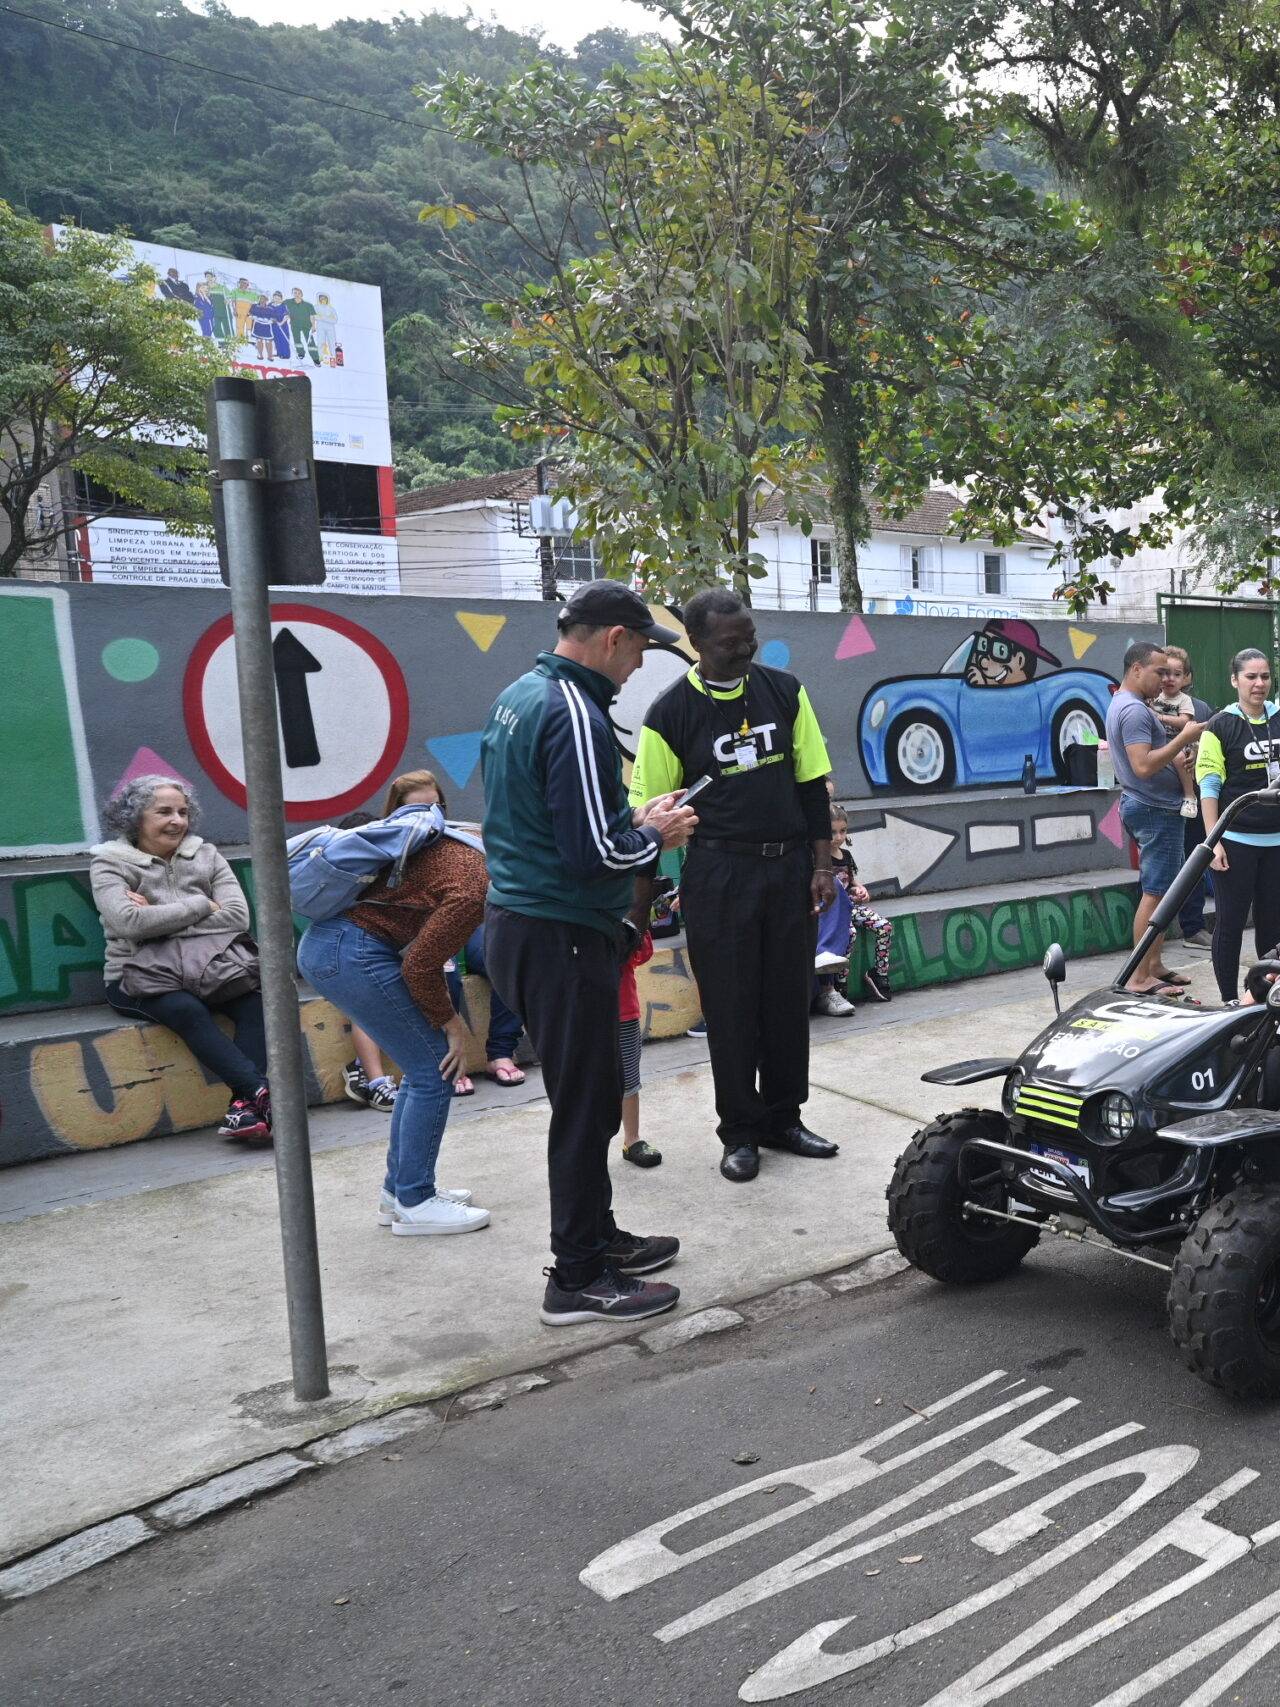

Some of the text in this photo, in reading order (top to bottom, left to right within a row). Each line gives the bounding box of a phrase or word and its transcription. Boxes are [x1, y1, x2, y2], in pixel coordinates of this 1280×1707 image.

[108, 537, 145, 545] LIMPEZA
[109, 546, 166, 555] EMPREGADOS
[112, 573, 153, 582] CONTROLE
[916, 601, 961, 617] Nova
[967, 603, 1019, 619] Forma
[1190, 1067, 1215, 1091] 01
